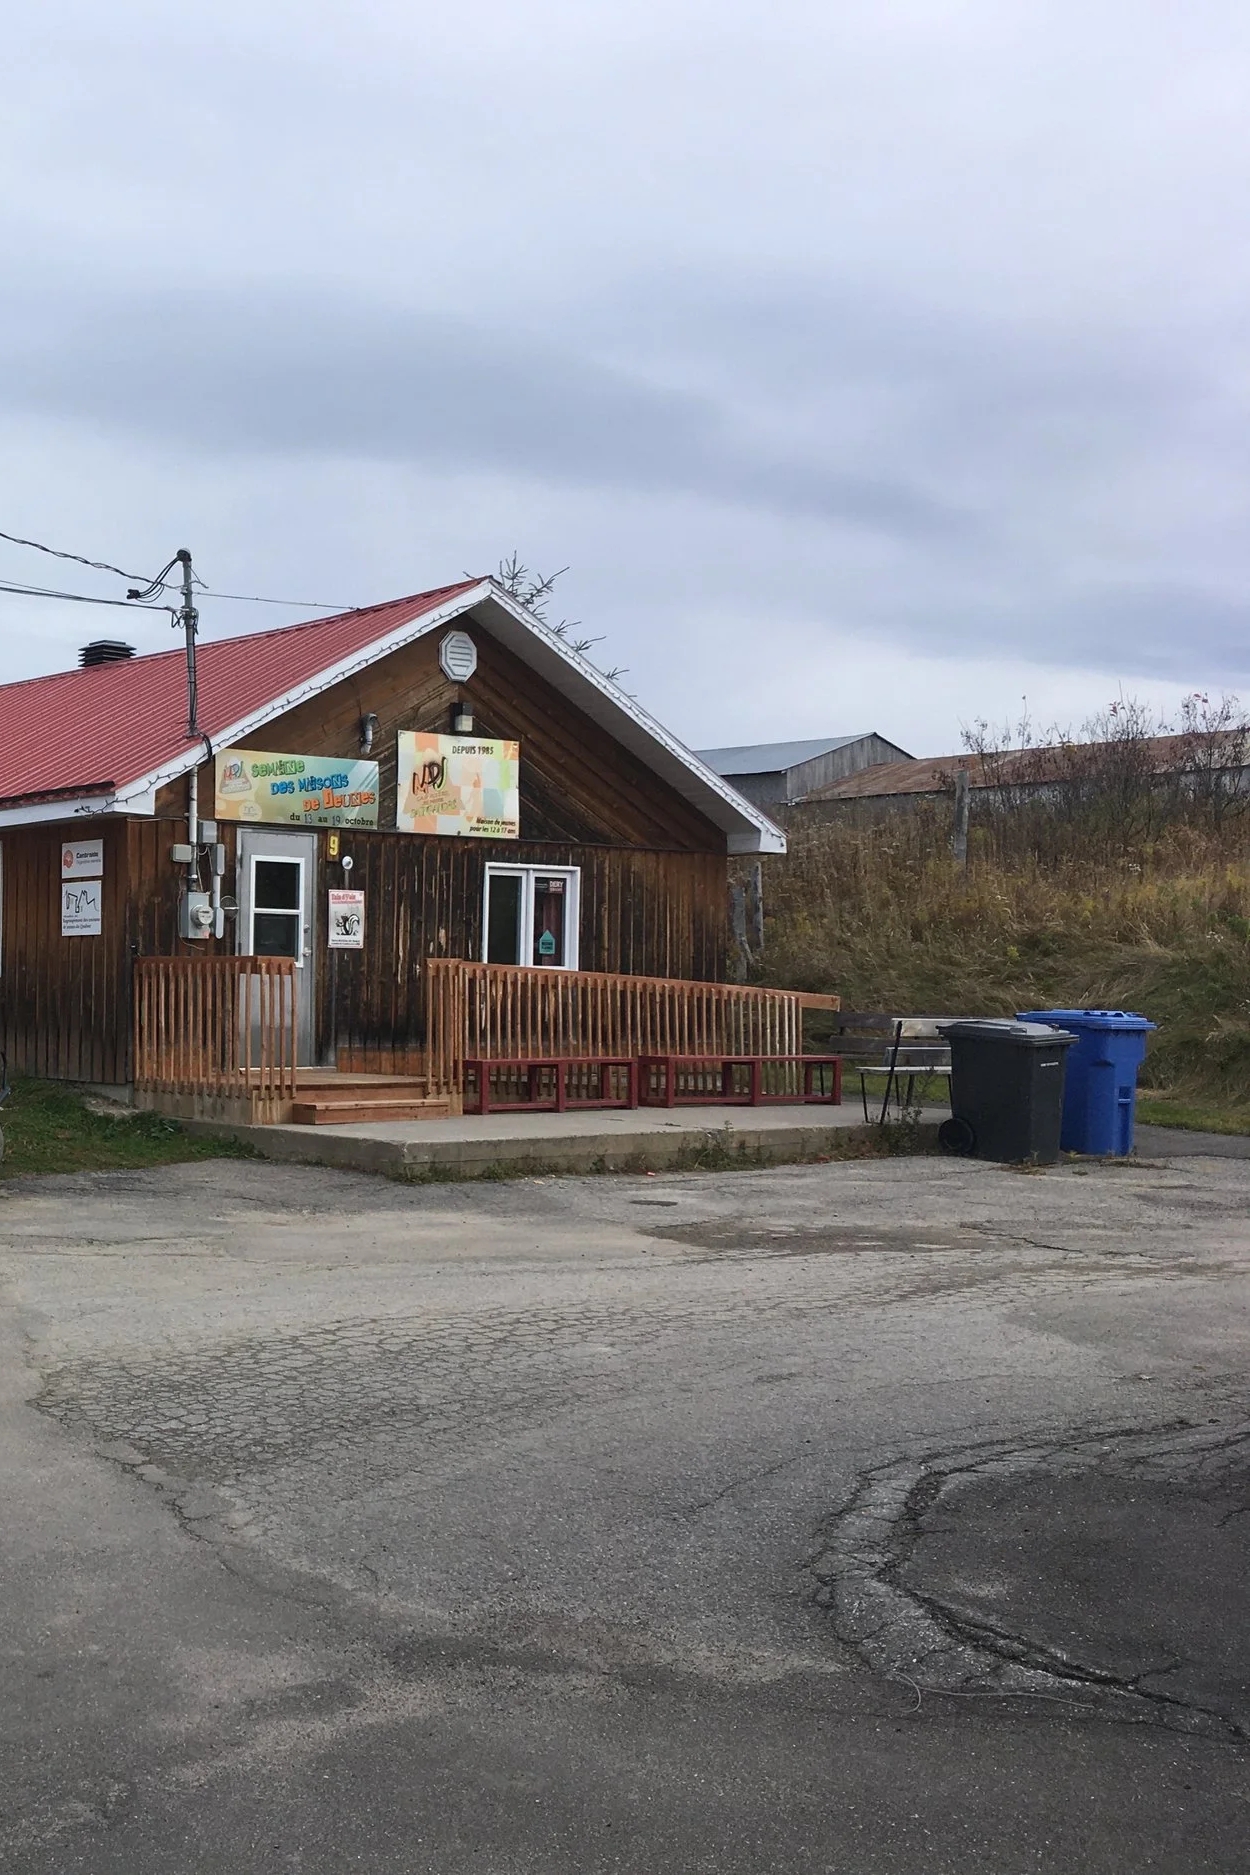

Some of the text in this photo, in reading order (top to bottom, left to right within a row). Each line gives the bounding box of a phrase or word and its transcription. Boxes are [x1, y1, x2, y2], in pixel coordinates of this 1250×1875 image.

[452, 746, 494, 755] DEPUIS 1985
[290, 812, 374, 826] du 13 au 19 octobre
[330, 836, 339, 856] 9
